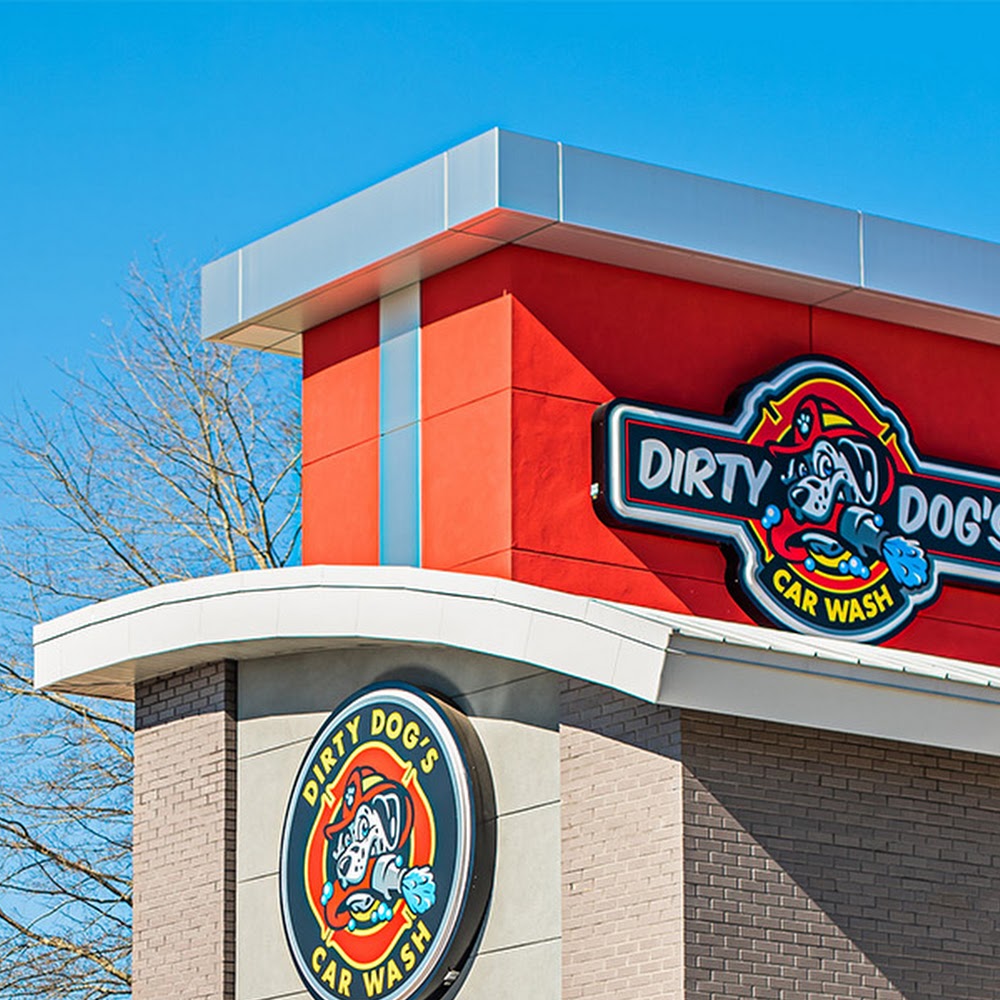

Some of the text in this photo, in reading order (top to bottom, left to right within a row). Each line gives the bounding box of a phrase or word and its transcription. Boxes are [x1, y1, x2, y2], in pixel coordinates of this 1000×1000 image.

[638, 438, 772, 507] DIRTY
[773, 568, 894, 623] CAR WASH
[302, 708, 440, 807] DIRTY DOG'S
[311, 920, 433, 998] CAR WASH
